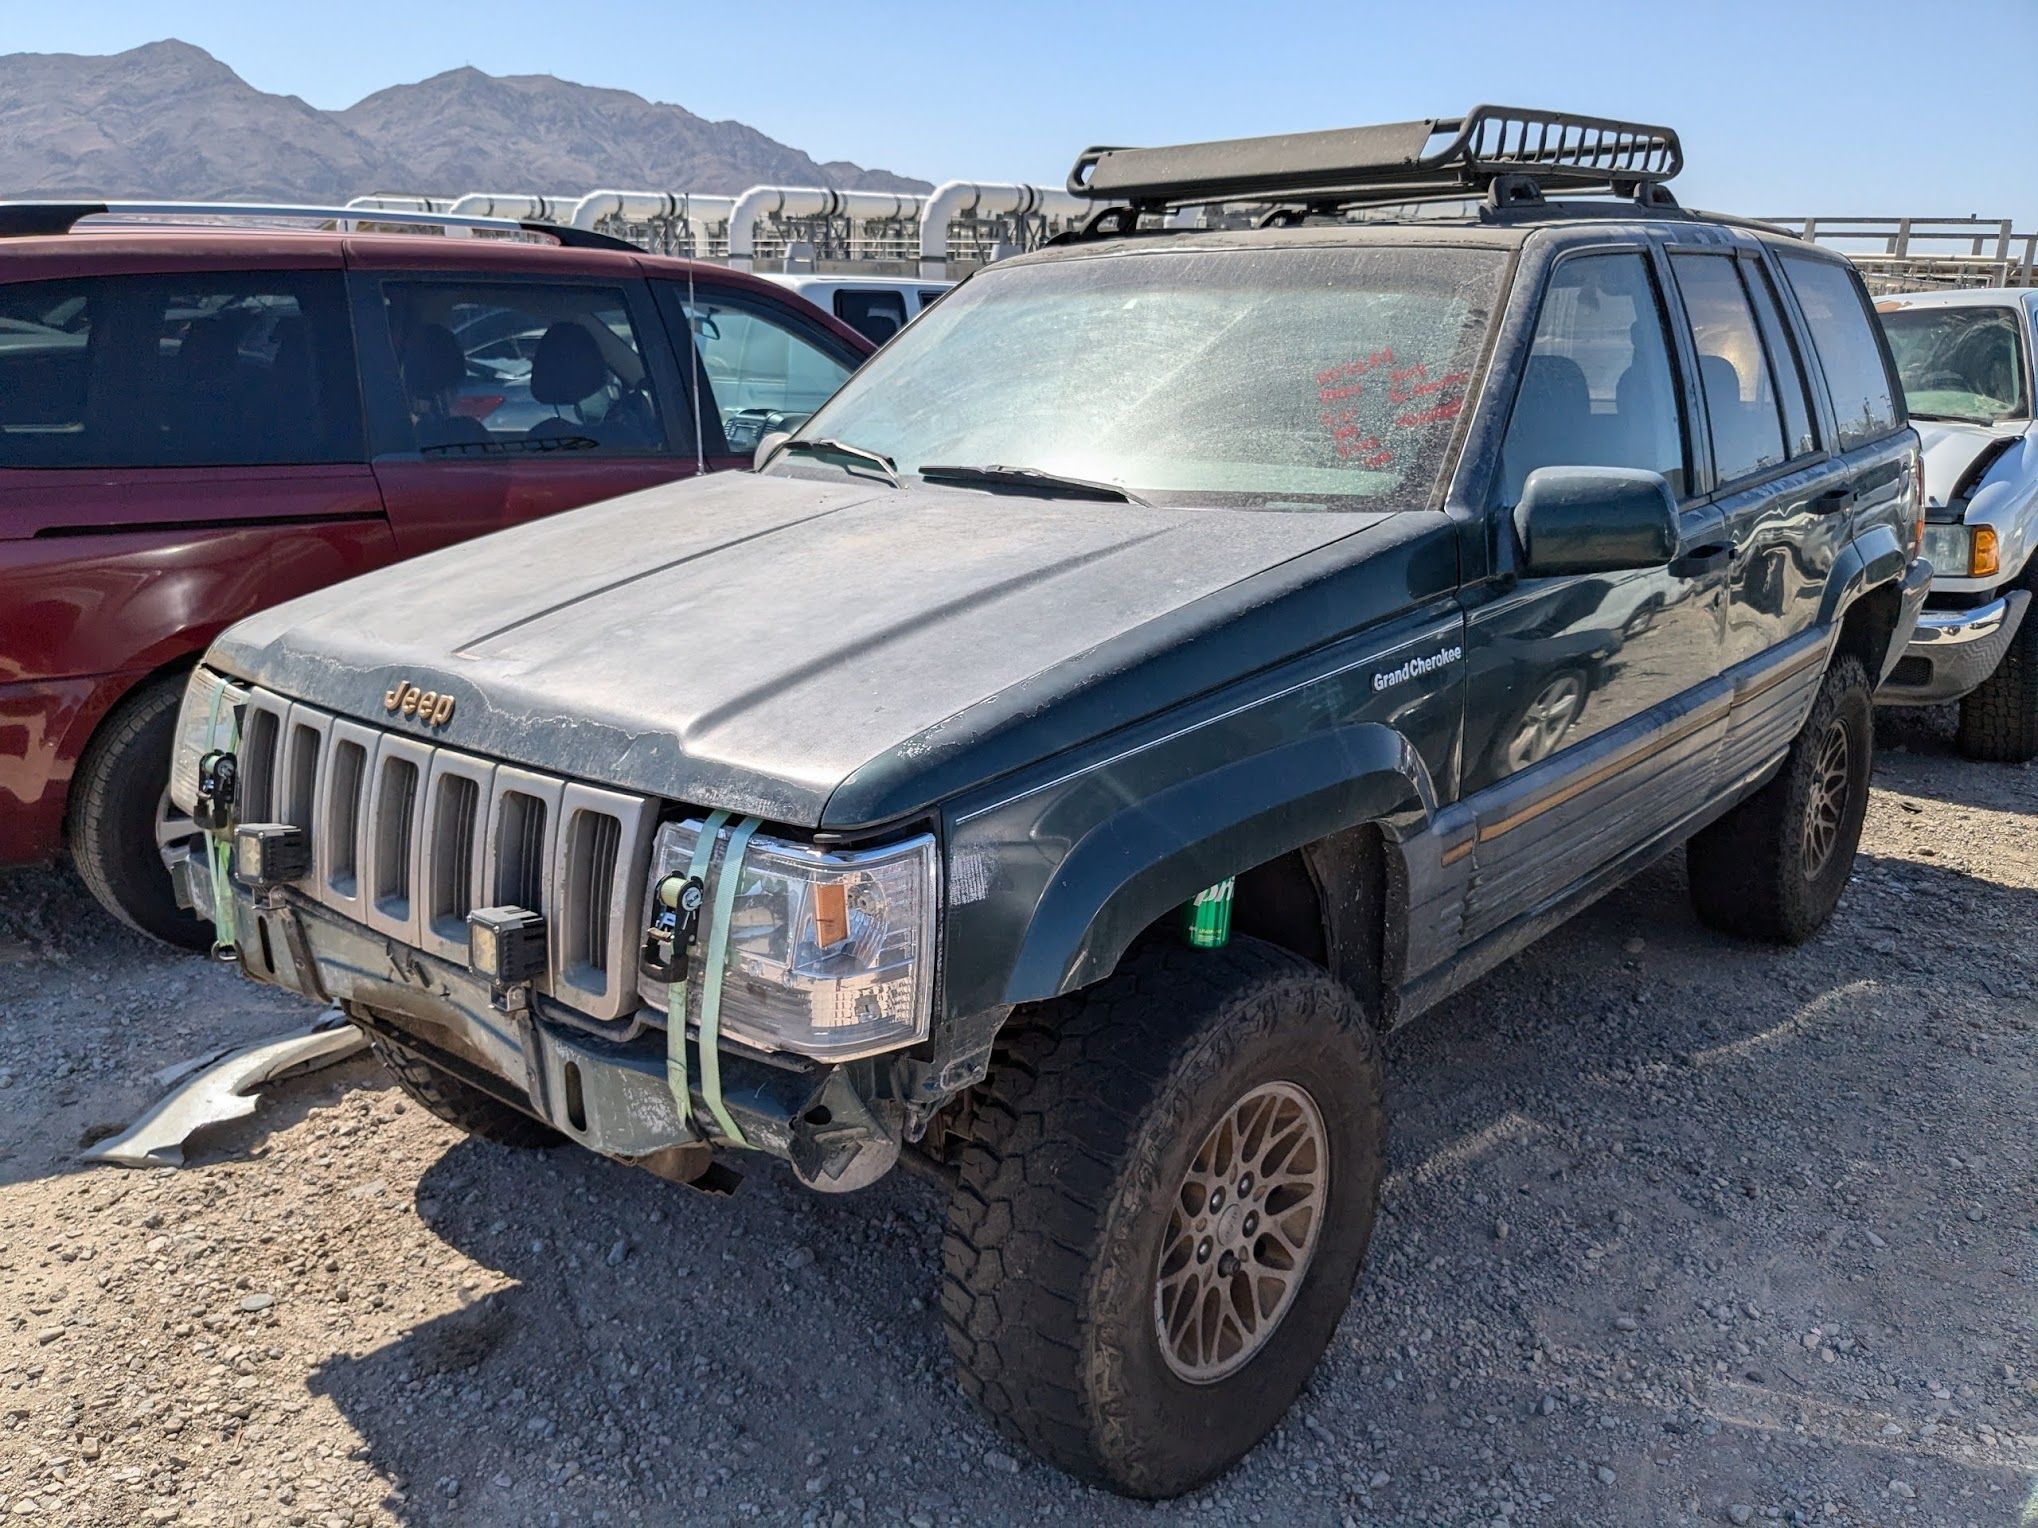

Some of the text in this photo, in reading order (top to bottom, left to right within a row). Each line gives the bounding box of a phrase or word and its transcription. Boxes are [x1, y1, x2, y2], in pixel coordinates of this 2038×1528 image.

[1373, 646, 1461, 691] Grand Cherokee
[384, 680, 455, 727] Jeep
